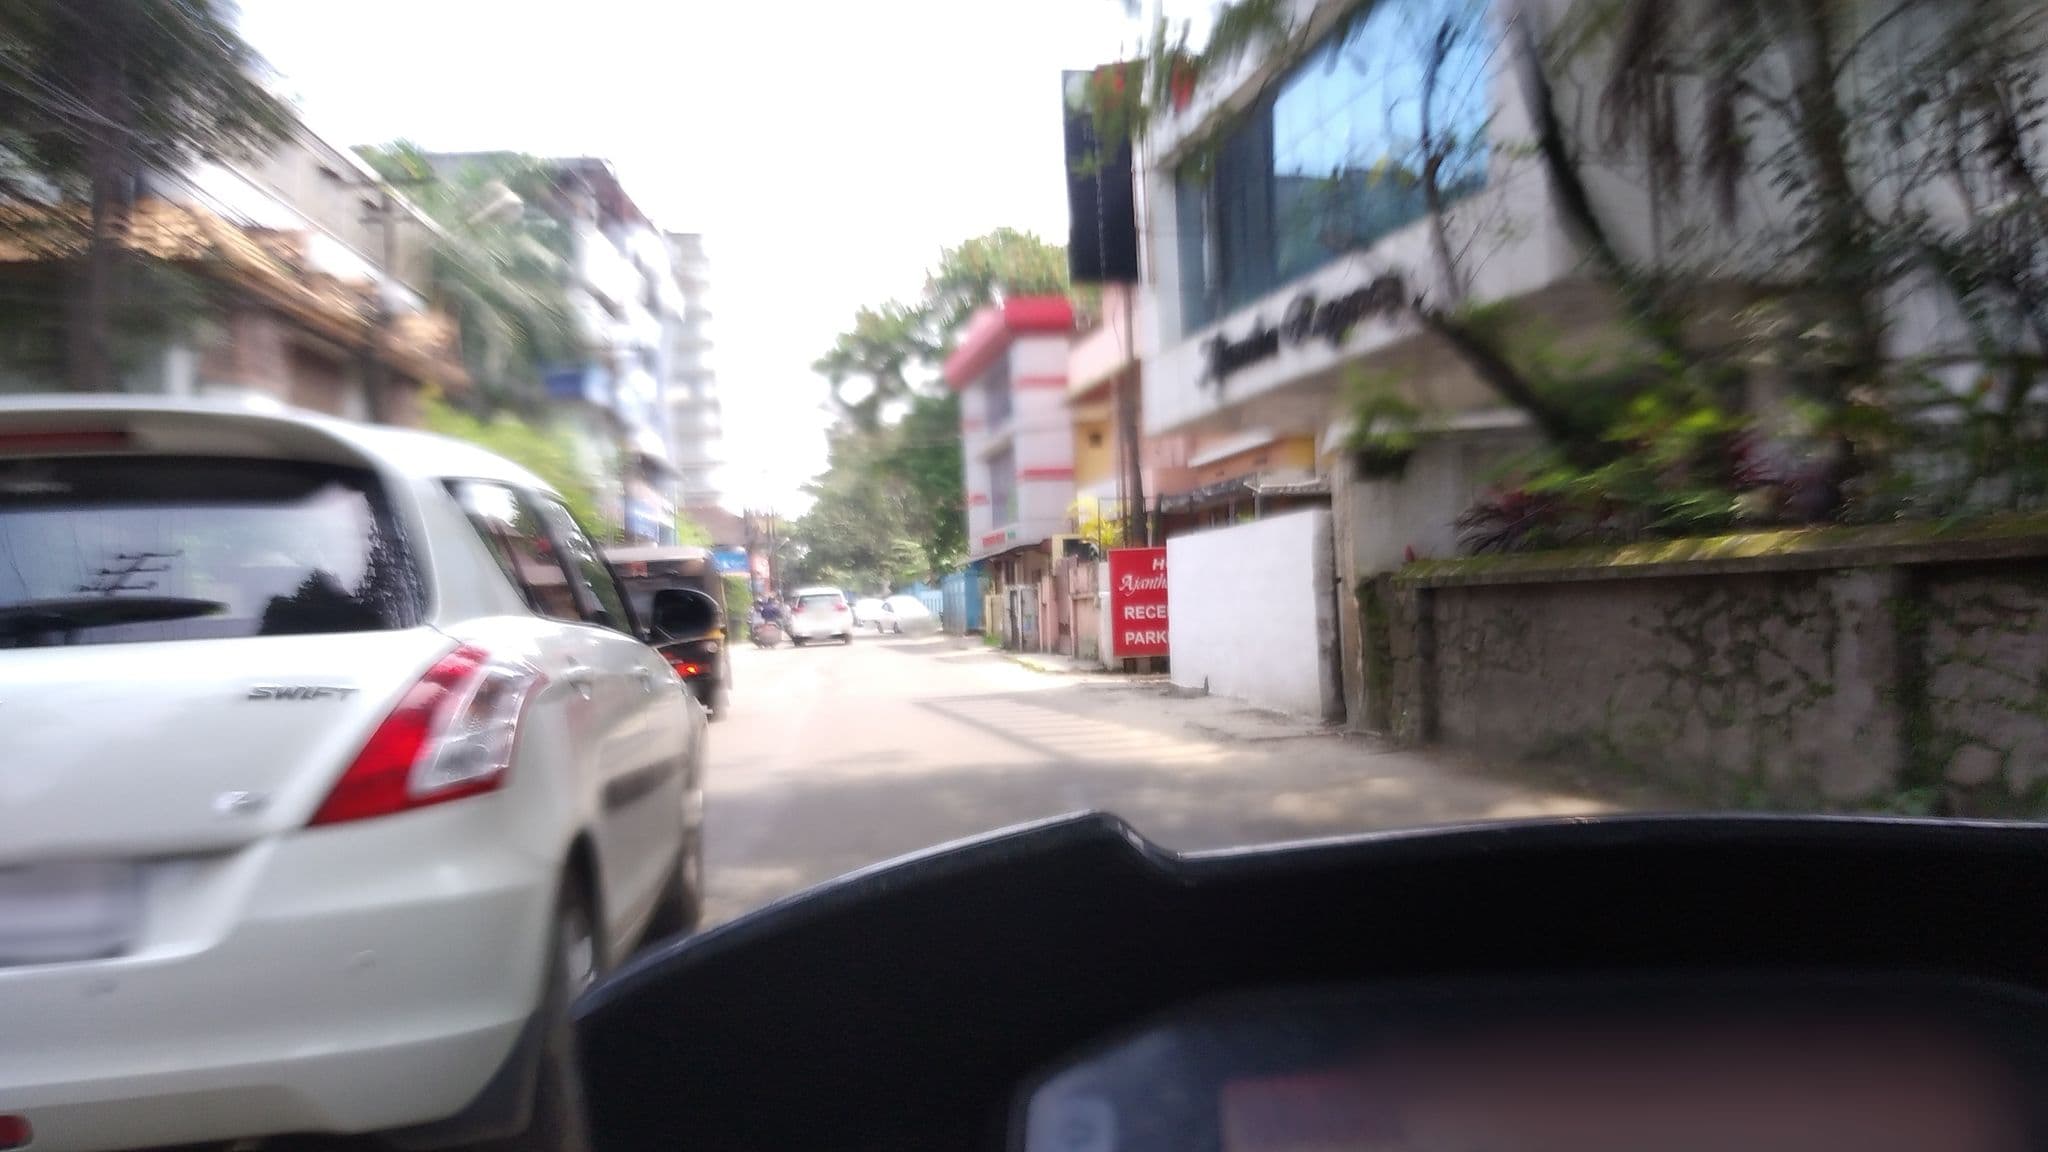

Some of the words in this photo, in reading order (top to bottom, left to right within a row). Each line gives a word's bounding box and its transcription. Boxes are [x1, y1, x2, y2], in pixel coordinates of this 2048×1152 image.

[1124, 605, 1167, 619] RECE
[1125, 630, 1167, 645] PARK
[248, 686, 360, 701] SWIFT
